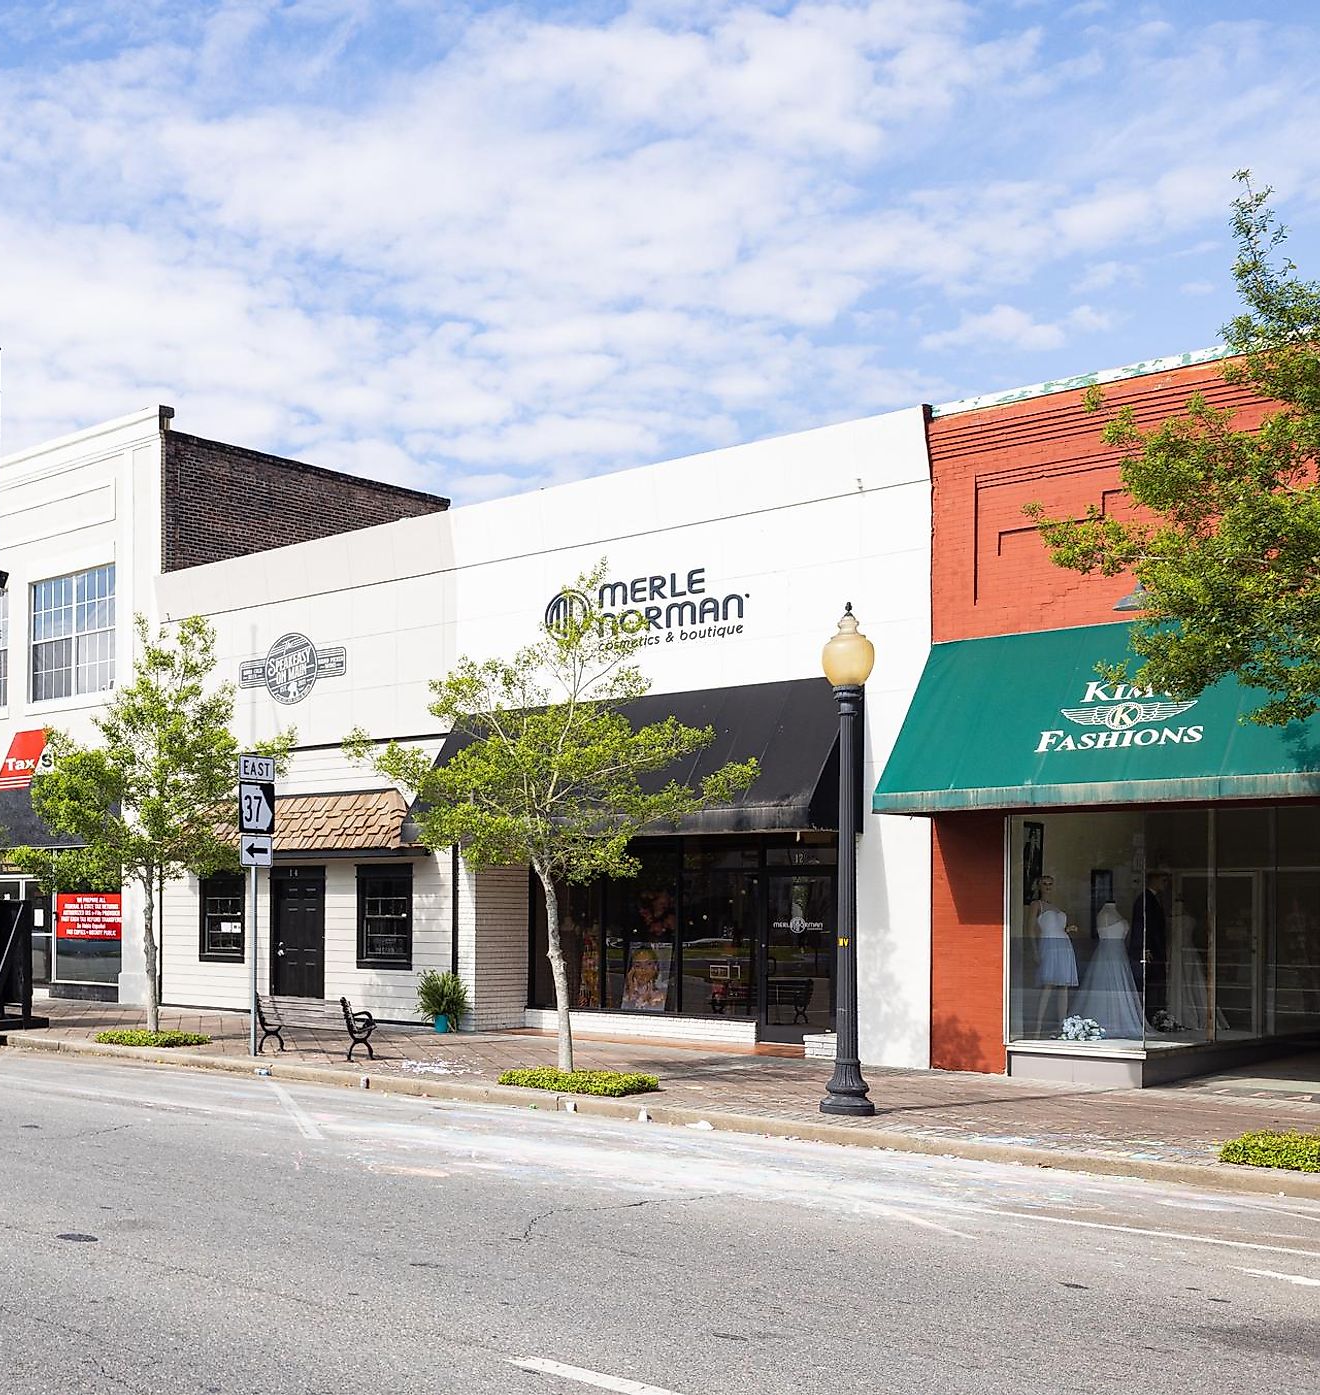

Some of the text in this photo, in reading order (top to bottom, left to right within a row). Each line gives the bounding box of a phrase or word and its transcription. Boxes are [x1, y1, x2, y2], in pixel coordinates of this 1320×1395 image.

[598, 567, 706, 608] MERLE
[601, 593, 744, 638] NORMAN
[598, 623, 744, 651] cosmetics & boutique
[1034, 725, 1204, 752] FASHIONS
[5, 758, 36, 771] Tax
[243, 760, 270, 777] EAST
[244, 795, 263, 822] 37
